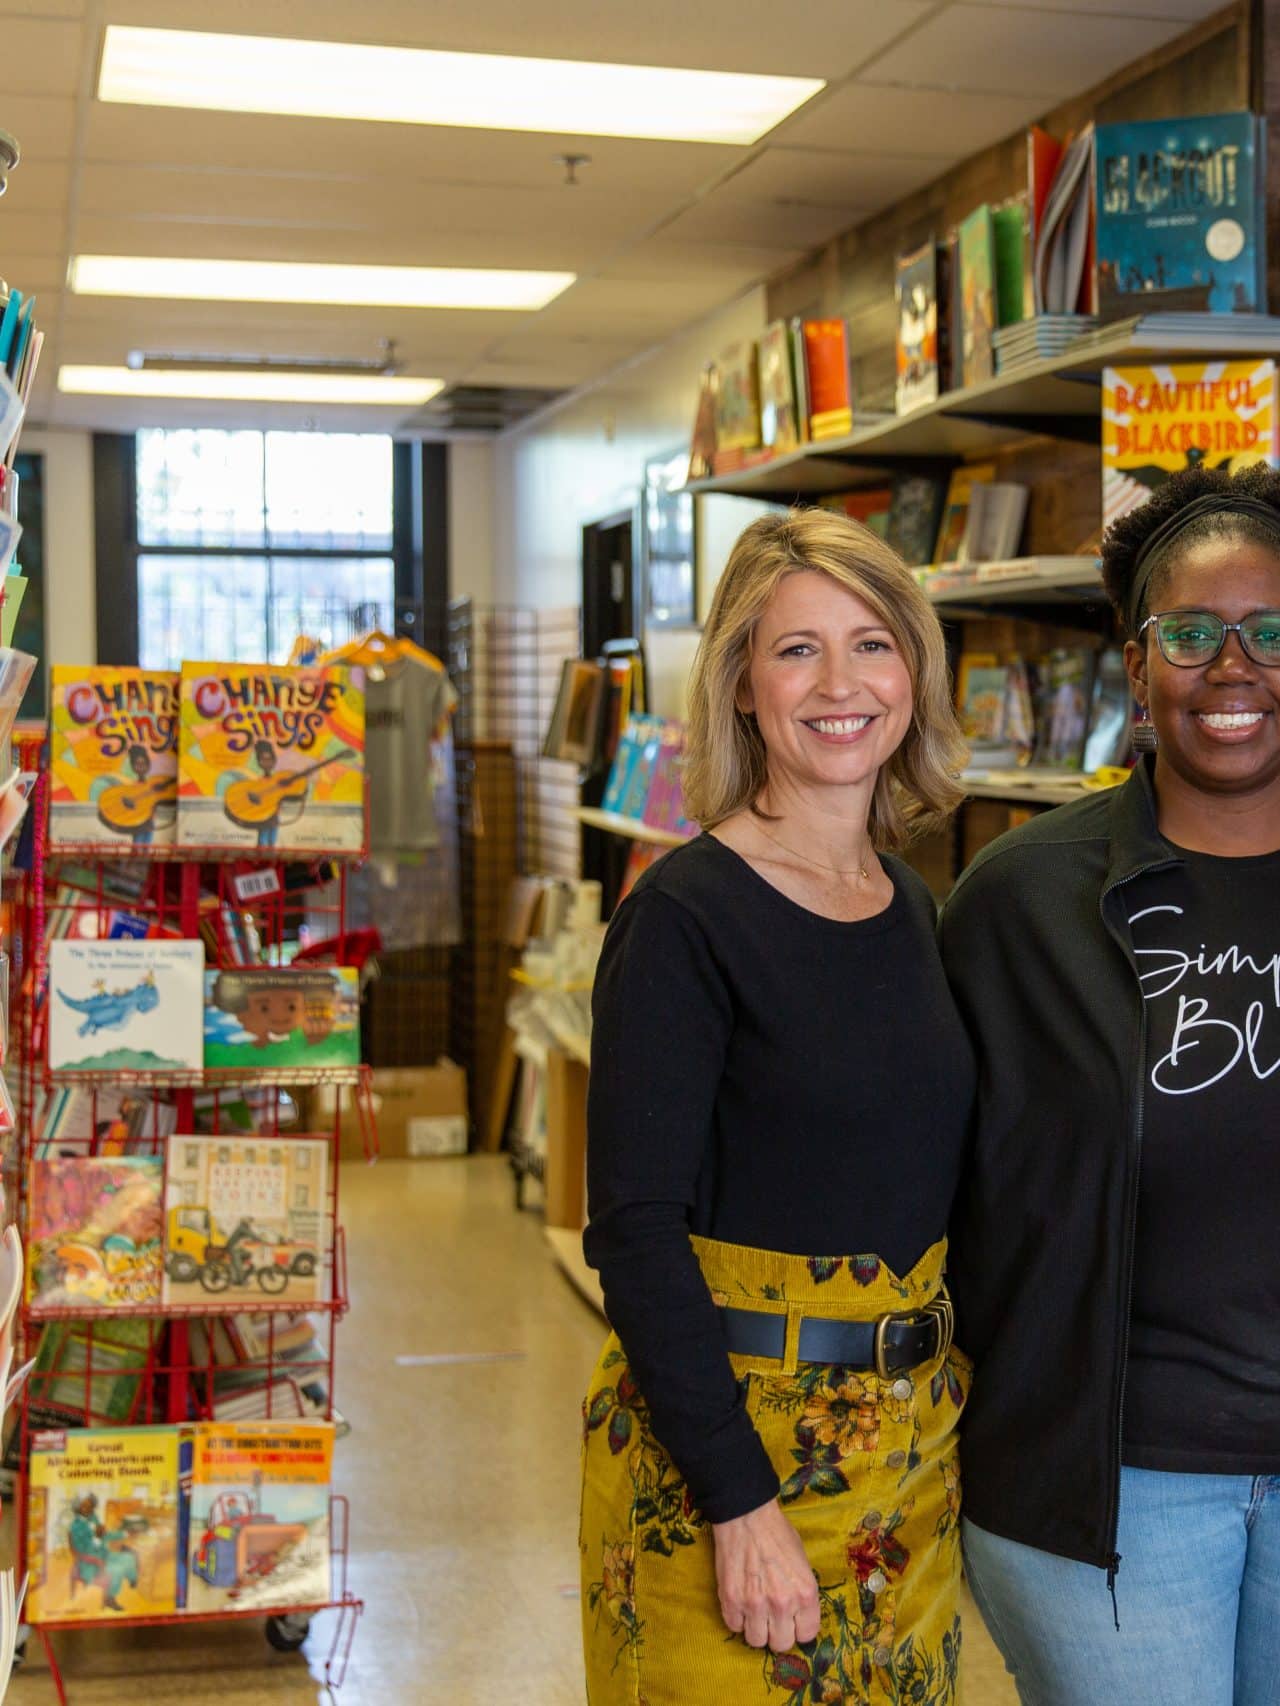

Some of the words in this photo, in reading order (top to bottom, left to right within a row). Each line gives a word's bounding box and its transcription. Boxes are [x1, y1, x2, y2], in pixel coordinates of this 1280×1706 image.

[1115, 378, 1258, 416] BEAUTIFUL
[1115, 418, 1259, 456] BLACKBIRD
[95, 716, 177, 757] Sing
